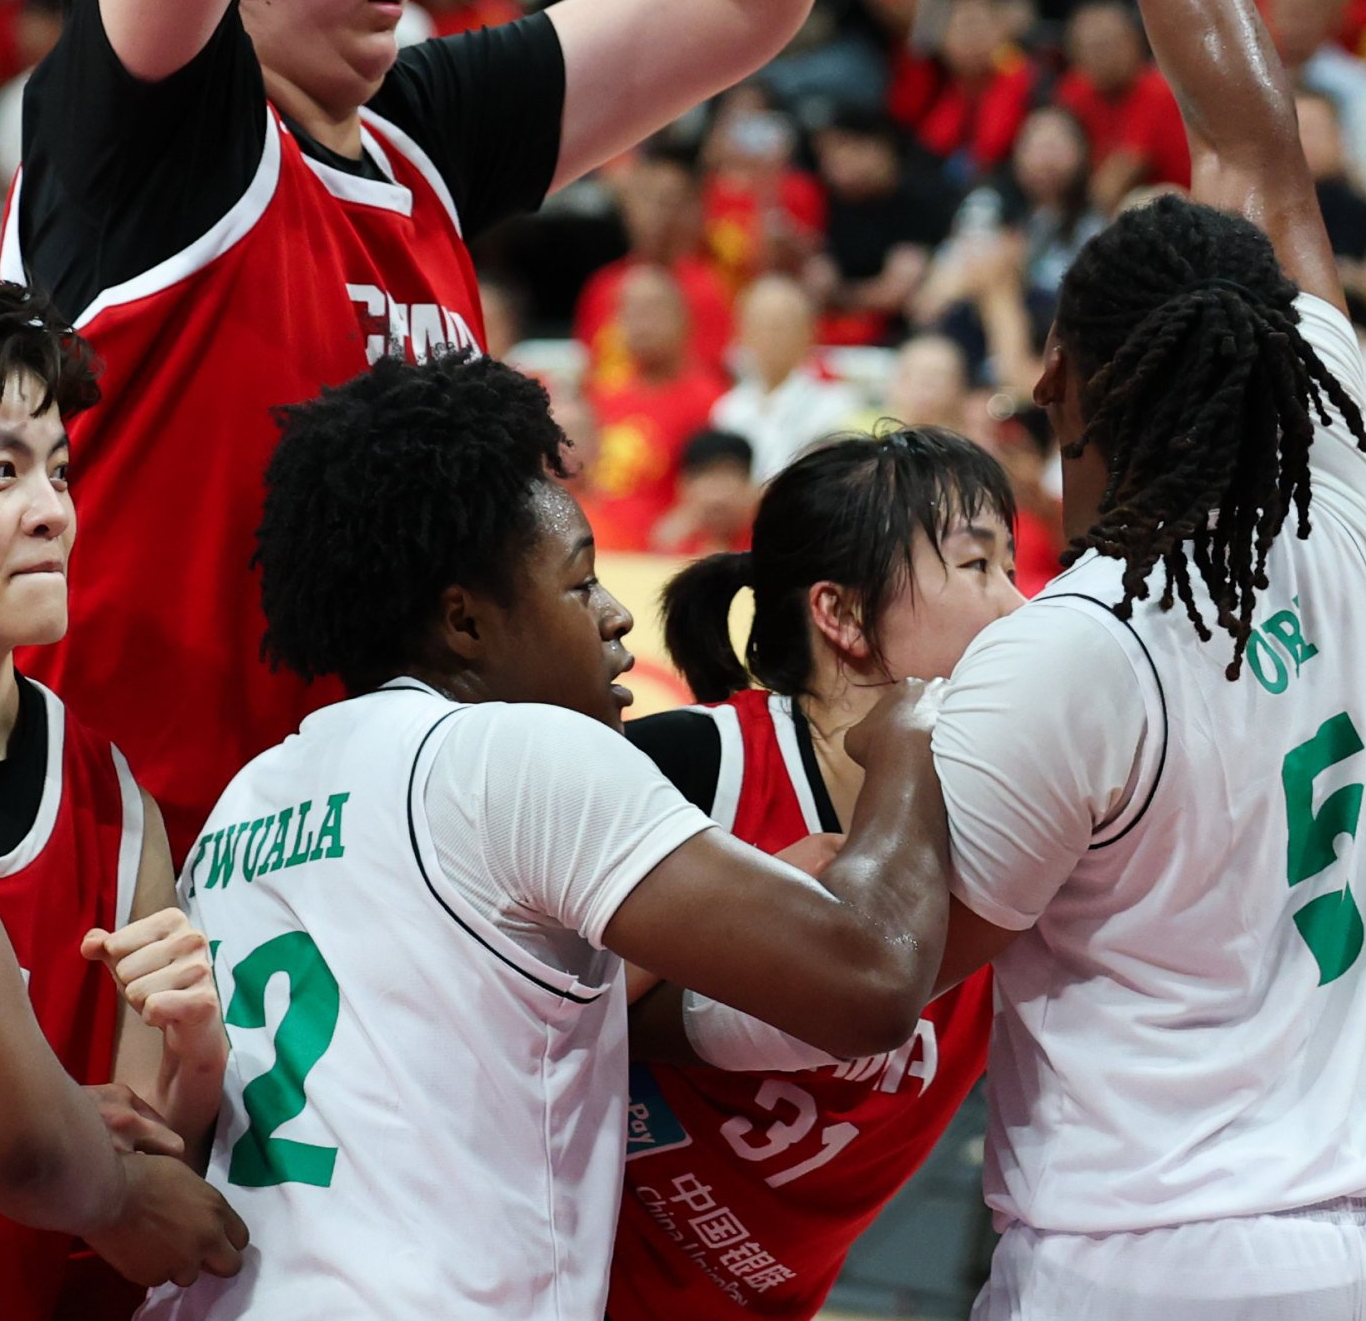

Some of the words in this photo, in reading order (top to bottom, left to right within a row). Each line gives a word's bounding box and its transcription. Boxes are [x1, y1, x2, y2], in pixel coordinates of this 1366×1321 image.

[1281, 711, 1365, 987] 5
[719, 1079, 860, 1189] 31
[670, 1172, 797, 1293] 中国银联
